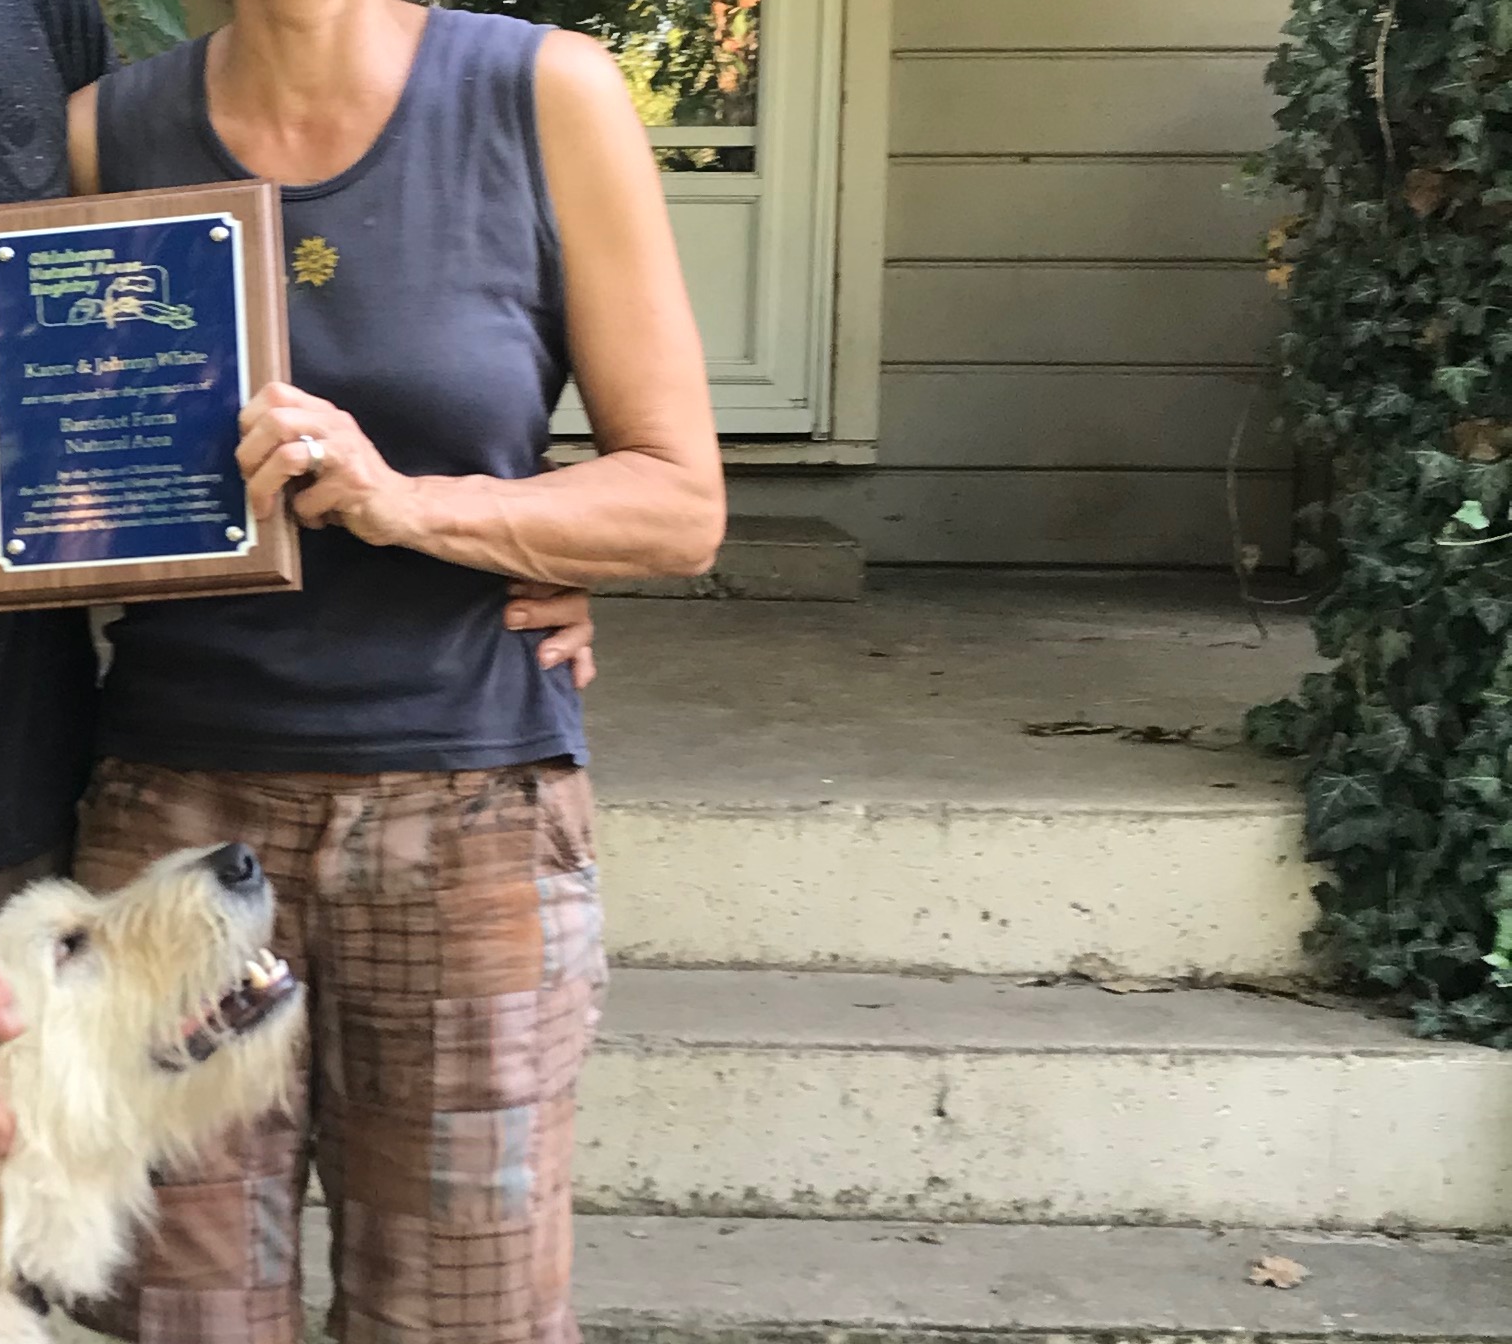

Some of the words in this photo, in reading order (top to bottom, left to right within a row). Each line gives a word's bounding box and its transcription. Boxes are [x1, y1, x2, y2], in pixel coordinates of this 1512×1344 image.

[28, 248, 115, 265] Oklahoma
[29, 262, 92, 281] Natural
[30, 280, 99, 298] Registry
[76, 359, 93, 373] &
[93, 356, 157, 375] Johnny
[155, 351, 208, 366] White
[65, 435, 129, 454] Natural
